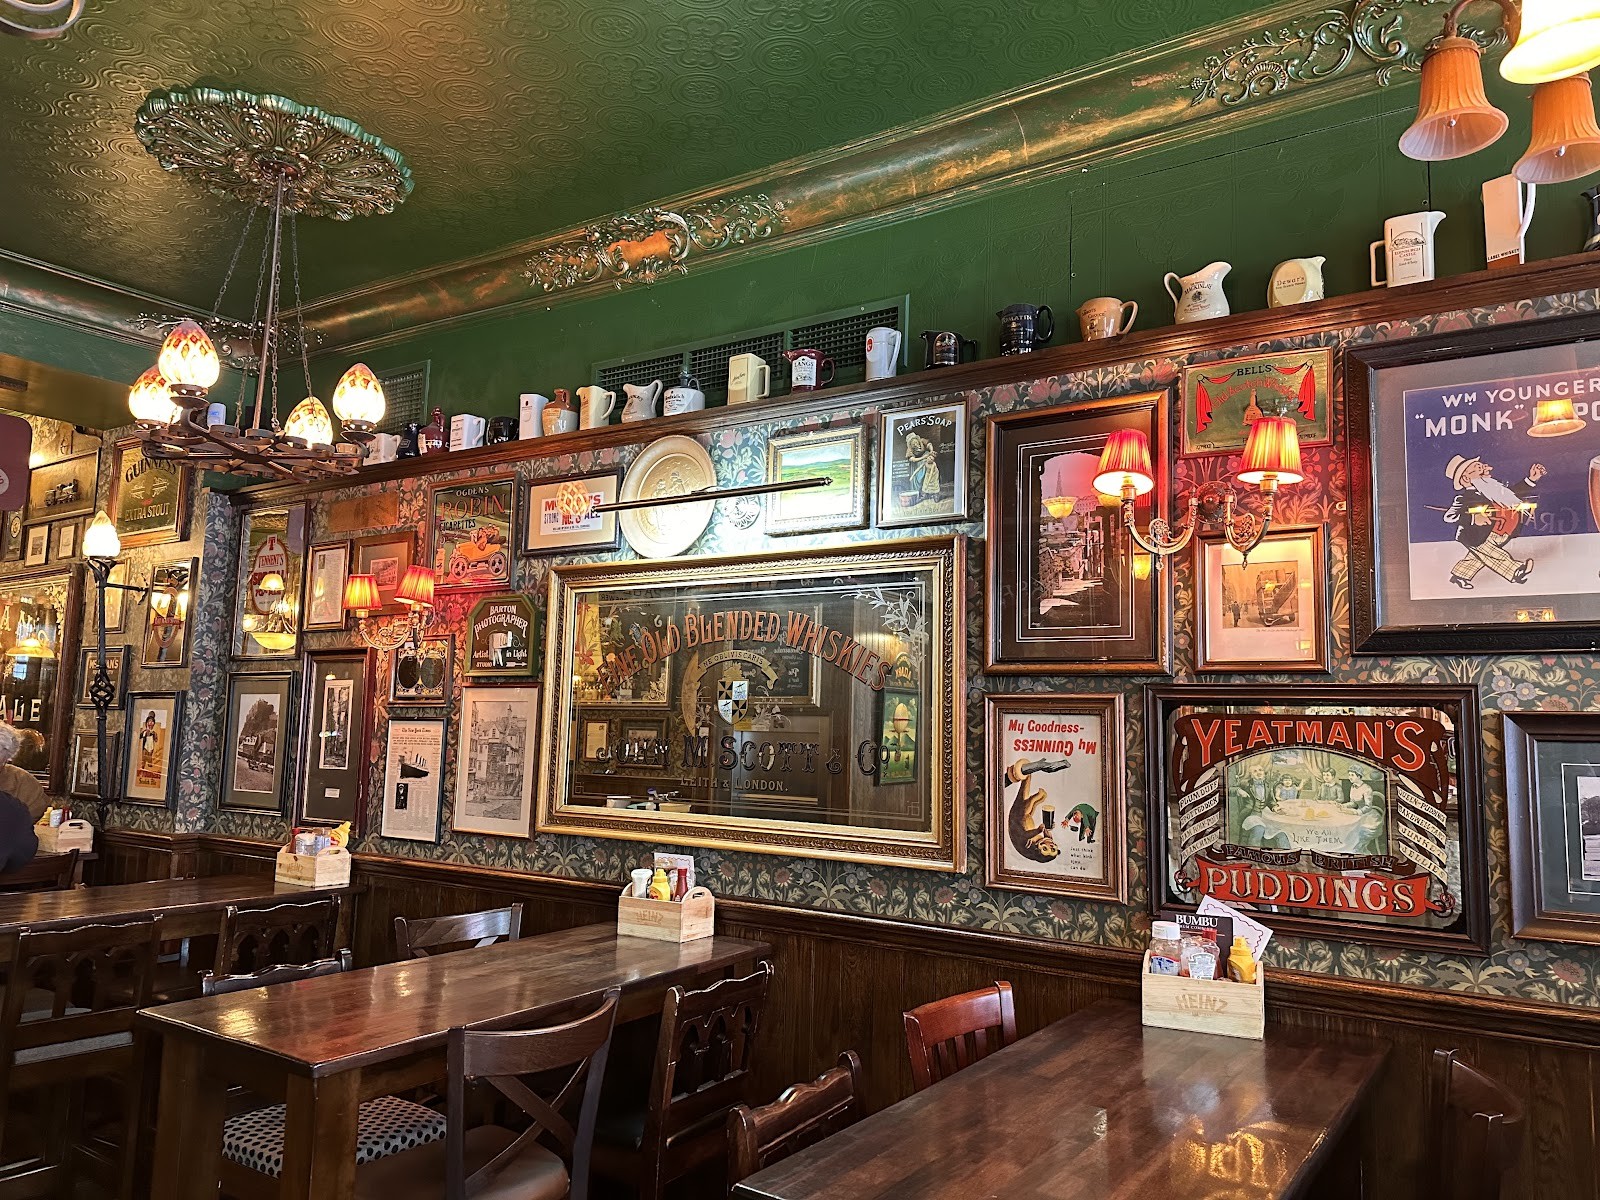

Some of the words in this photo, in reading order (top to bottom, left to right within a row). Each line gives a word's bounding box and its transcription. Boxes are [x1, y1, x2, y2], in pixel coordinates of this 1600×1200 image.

[1487, 253, 1500, 261] LABEL
[1276, 276, 1305, 286] Dewar's
[1236, 364, 1273, 377] BELL'S
[926, 415, 953, 428] SOAP
[125, 457, 177, 483] GUINNESS
[125, 507, 147, 523] EXTRA
[147, 502, 171, 518] STOUT
[440, 493, 507, 521] ROBIN
[440, 519, 476, 532] CIGARETTES
[258, 553, 285, 569] TENNENT'S
[490, 605, 517, 616] BARTON
[473, 613, 529, 641] PHOTOGRAPHER
[505, 649, 512, 658] in
[512, 648, 528, 661] Light
[596, 643, 643, 696] FINE
[640, 623, 681, 664] OLD
[684, 610, 781, 648] BLENDED
[787, 610, 894, 692] WHISKIES
[1008, 719, 1025, 734] My
[1013, 738, 1075, 757] GUINNESS
[1078, 739, 1098, 755] My
[1190, 718, 1427, 772] YEATMAN'S
[595, 735, 672, 768] JOHN
[718, 735, 820, 774] SCOTT
[825, 748, 843, 775] &
[680, 776, 719, 790] LEITH
[722, 779, 731, 792] &
[1179, 791, 1200, 809] PLUM
[1200, 780, 1218, 796] DUFF
[1292, 832, 1310, 844] LIKE
[1315, 835, 1343, 845] THEM
[1401, 826, 1444, 857] JUNKET
[1225, 843, 1299, 866] FAMOUS
[1313, 853, 1397, 870] BRITISH
[1401, 846, 1446, 878] JELLIES
[1207, 867, 1415, 913] PUDDINGS
[635, 909, 664, 923] HEINZ
[1175, 913, 1219, 928] BUMBU
[1174, 993, 1229, 1014] HEINZ
